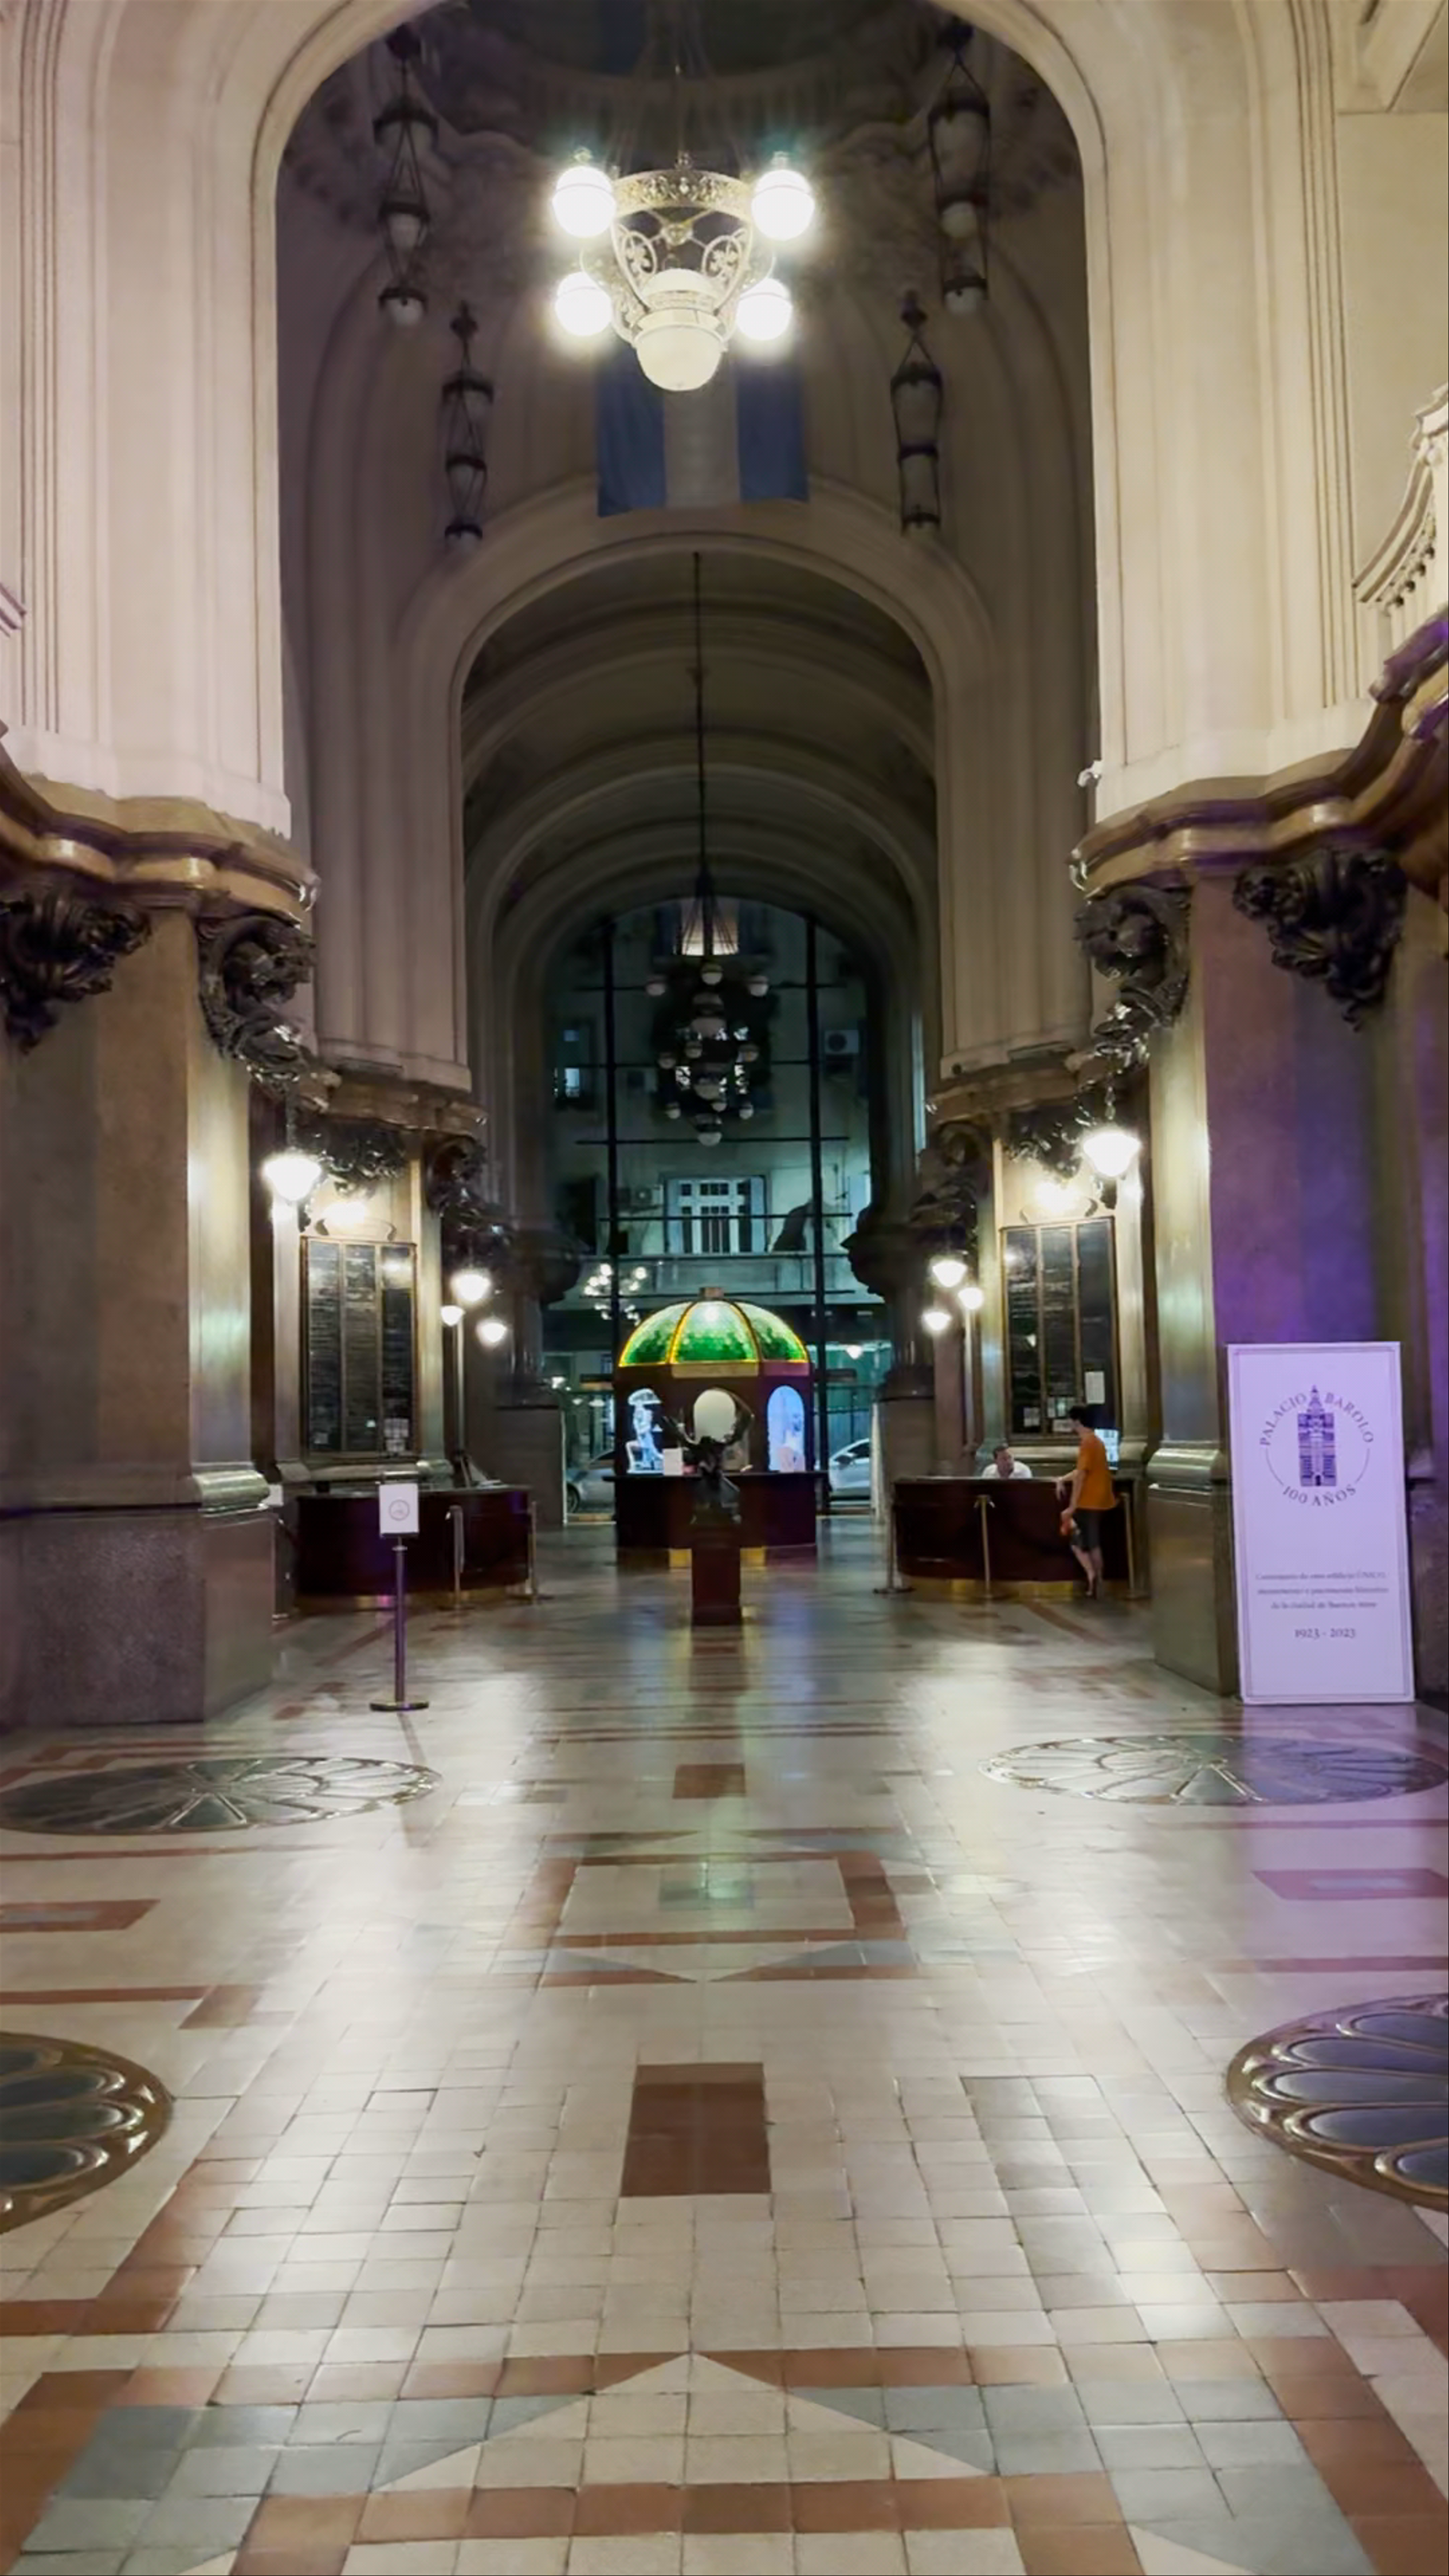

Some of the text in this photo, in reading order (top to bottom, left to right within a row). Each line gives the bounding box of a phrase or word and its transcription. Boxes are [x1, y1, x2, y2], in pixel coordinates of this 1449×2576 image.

[1260, 1392, 1374, 1446] PALACIO BAROLO
[1283, 1484, 1356, 1506] 100 AÑOS
[1294, 1628, 1320, 1639] 1923
[1330, 1627, 1356, 1638] 2023
